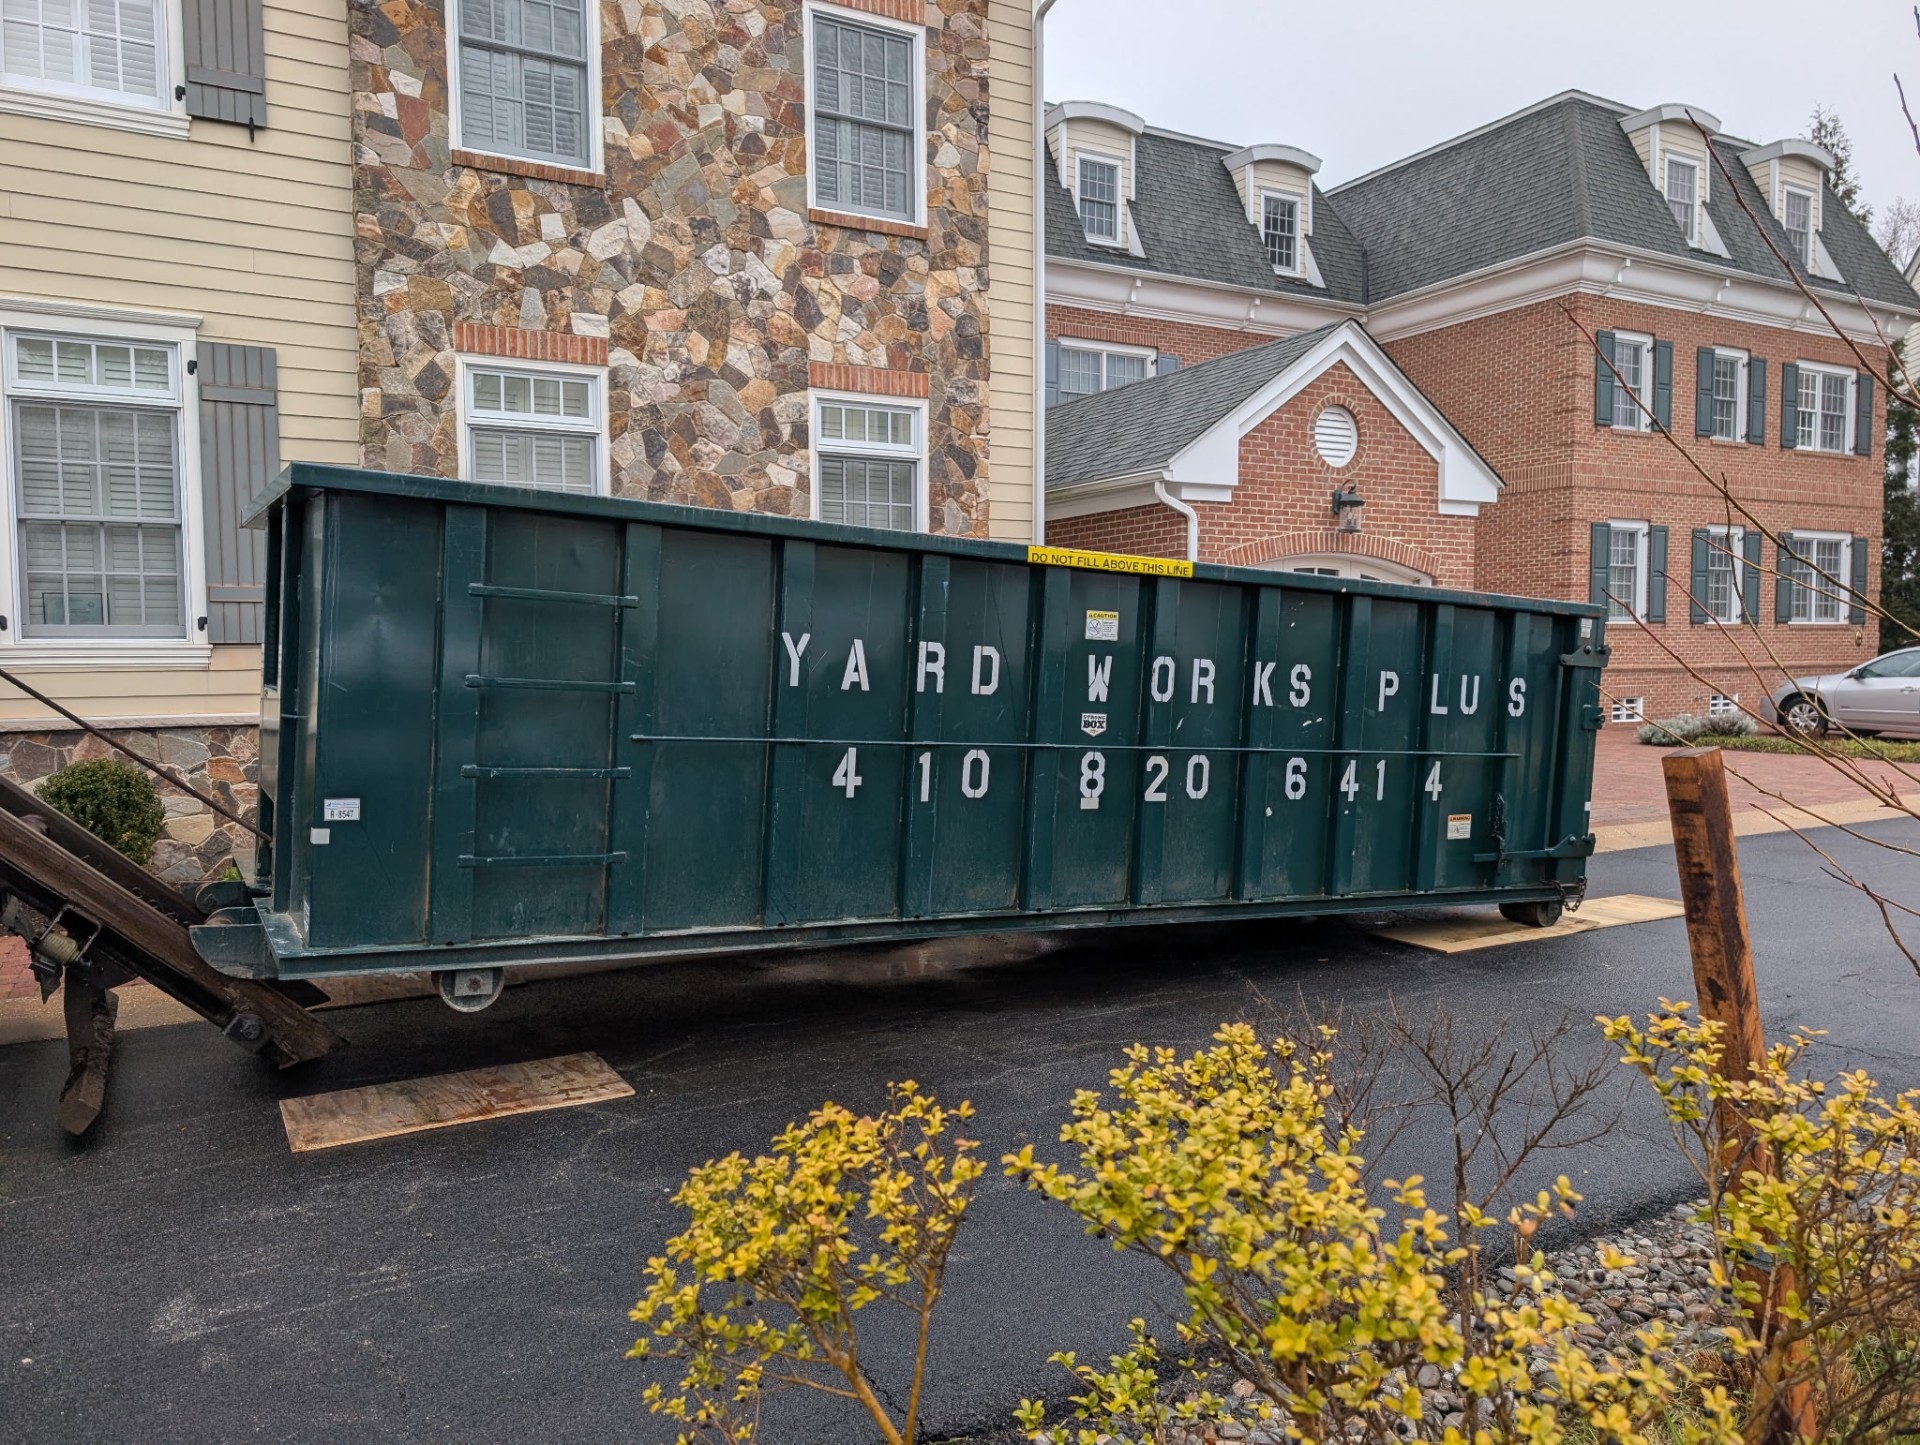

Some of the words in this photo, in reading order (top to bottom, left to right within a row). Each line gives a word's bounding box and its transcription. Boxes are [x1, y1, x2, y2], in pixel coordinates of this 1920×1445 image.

[1031, 552, 1048, 563] DO
[1051, 554, 1074, 565] NOT
[1077, 556, 1099, 568] FILL
[1103, 558, 1139, 571] ABOVE
[1142, 562, 1165, 574] THIS
[1167, 565, 1189, 576] LINE
[782, 632, 1000, 695] YARD
[1088, 655, 1312, 708] WORKS
[1378, 671, 1526, 717] PLUS
[1083, 719, 1105, 729] BOX
[832, 747, 990, 802] 410
[1080, 751, 1210, 802] 820
[1285, 757, 1442, 802] 6414
